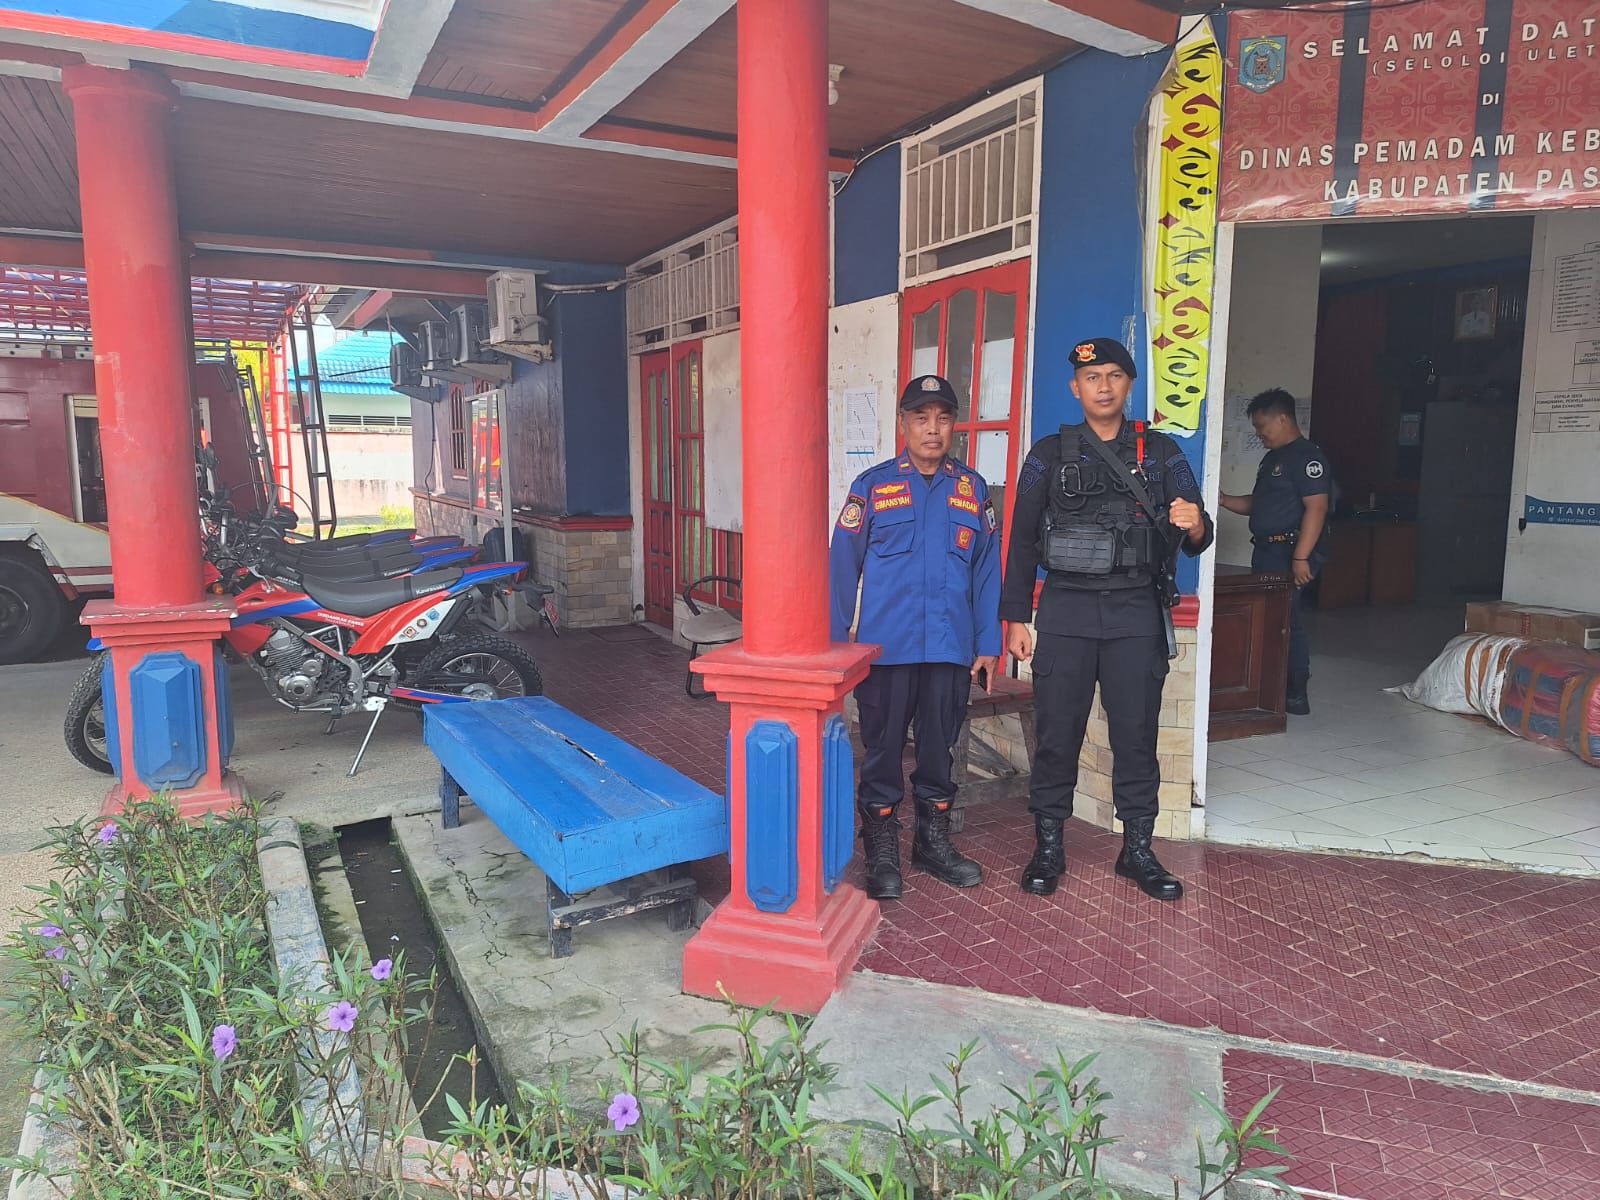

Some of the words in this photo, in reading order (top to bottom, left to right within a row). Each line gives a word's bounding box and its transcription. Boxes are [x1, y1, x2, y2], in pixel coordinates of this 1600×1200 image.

[1302, 26, 1489, 59] SELAMAT
[1481, 93, 1500, 106] DI
[1239, 144, 1334, 170] DINAS
[1353, 134, 1515, 164] PEMADAM
[1536, 128, 1600, 154] KEB
[1324, 171, 1514, 201] KABUPATEN
[1536, 166, 1600, 191] PAS
[1528, 505, 1596, 516] PANTANG
